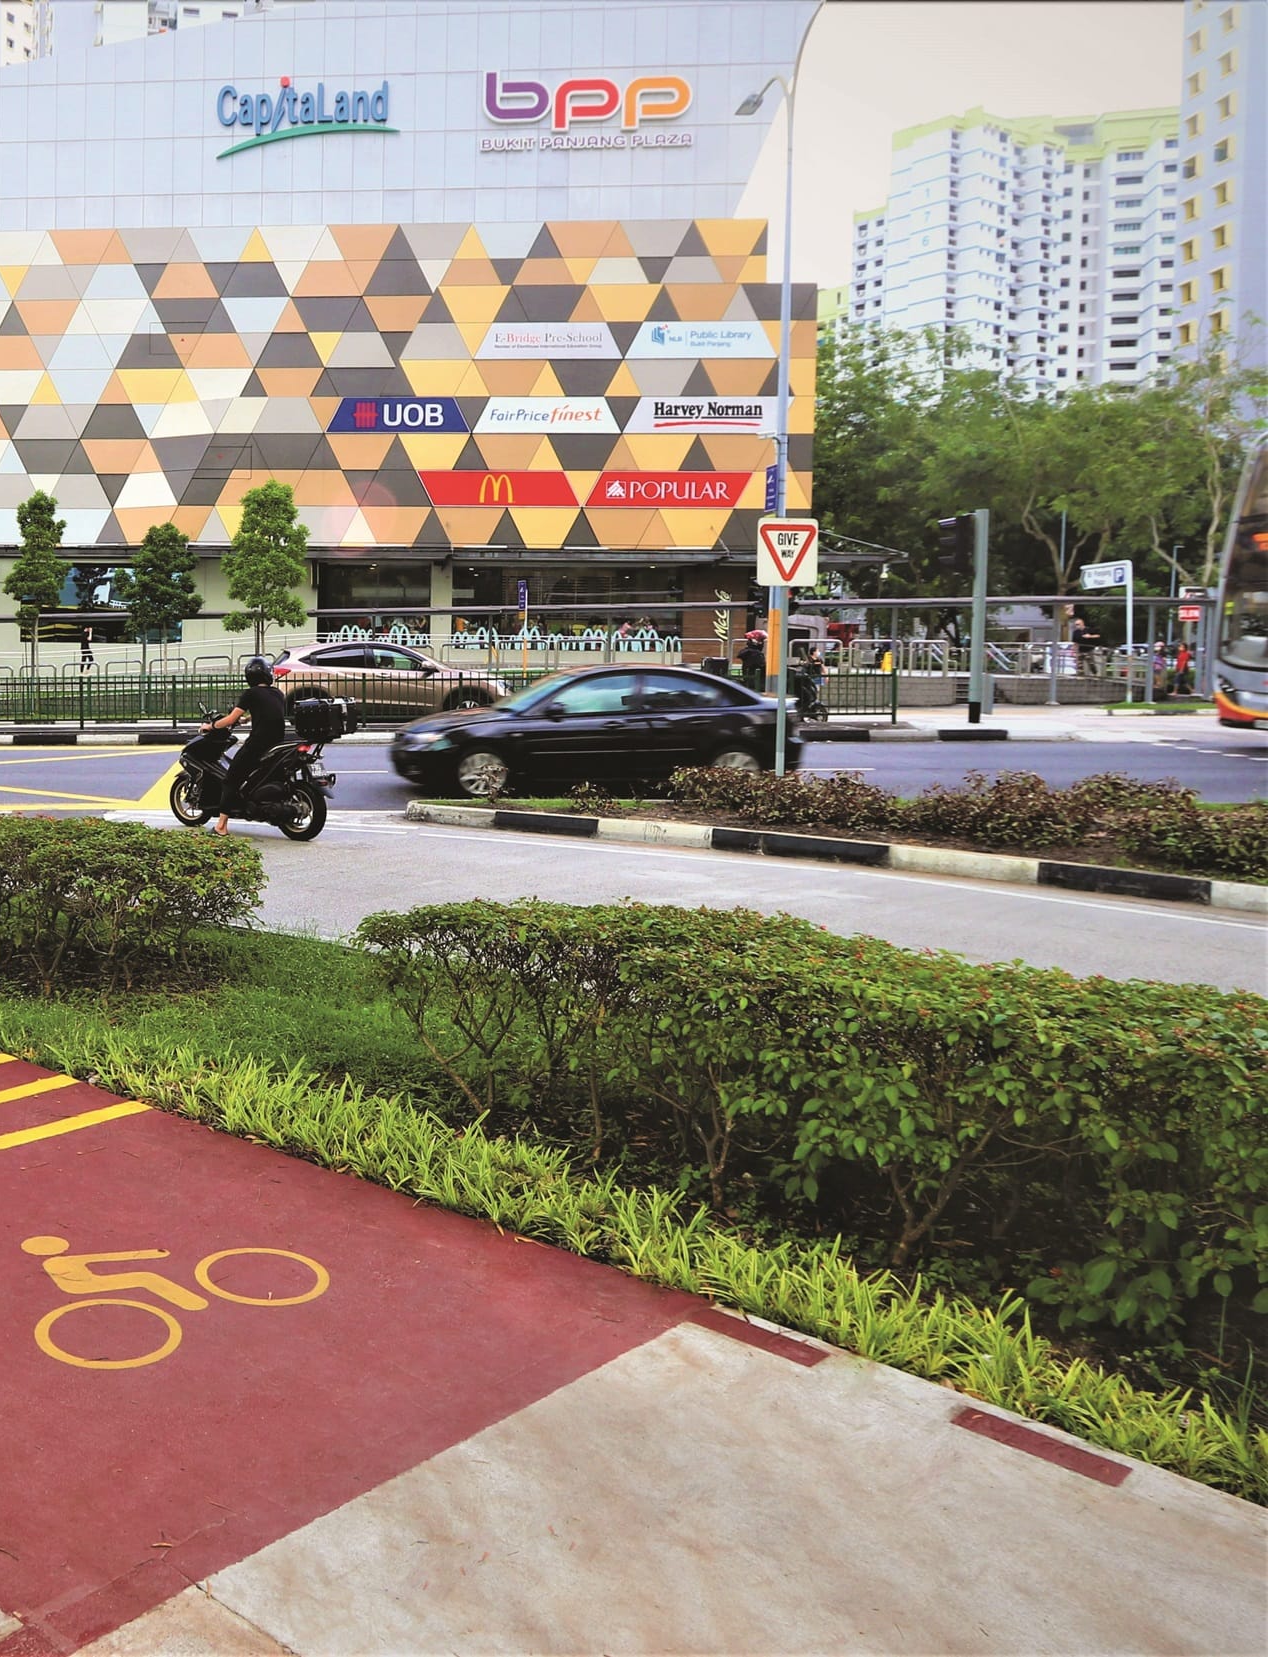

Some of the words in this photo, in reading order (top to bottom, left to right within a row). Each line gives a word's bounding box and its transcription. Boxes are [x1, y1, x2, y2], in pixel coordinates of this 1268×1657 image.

[217, 76, 389, 136] CapitaLand
[484, 71, 692, 132] bpp
[481, 137, 535, 151] BUKIT
[540, 135, 626, 150] PANJANG
[632, 132, 692, 149] PLAZA
[495, 332, 541, 343] E-Bridge
[545, 332, 603, 342] Pre-School
[689, 330, 718, 339] Public
[720, 330, 752, 341] Library
[383, 403, 444, 427] UOB
[489, 407, 549, 422] FairPrice
[550, 404, 604, 424] finest
[654, 401, 704, 419] Harvey
[707, 401, 763, 417] Norman
[630, 480, 731, 501] POPULAR
[777, 532, 799, 546] GIVE
[781, 549, 795, 558] WAY
